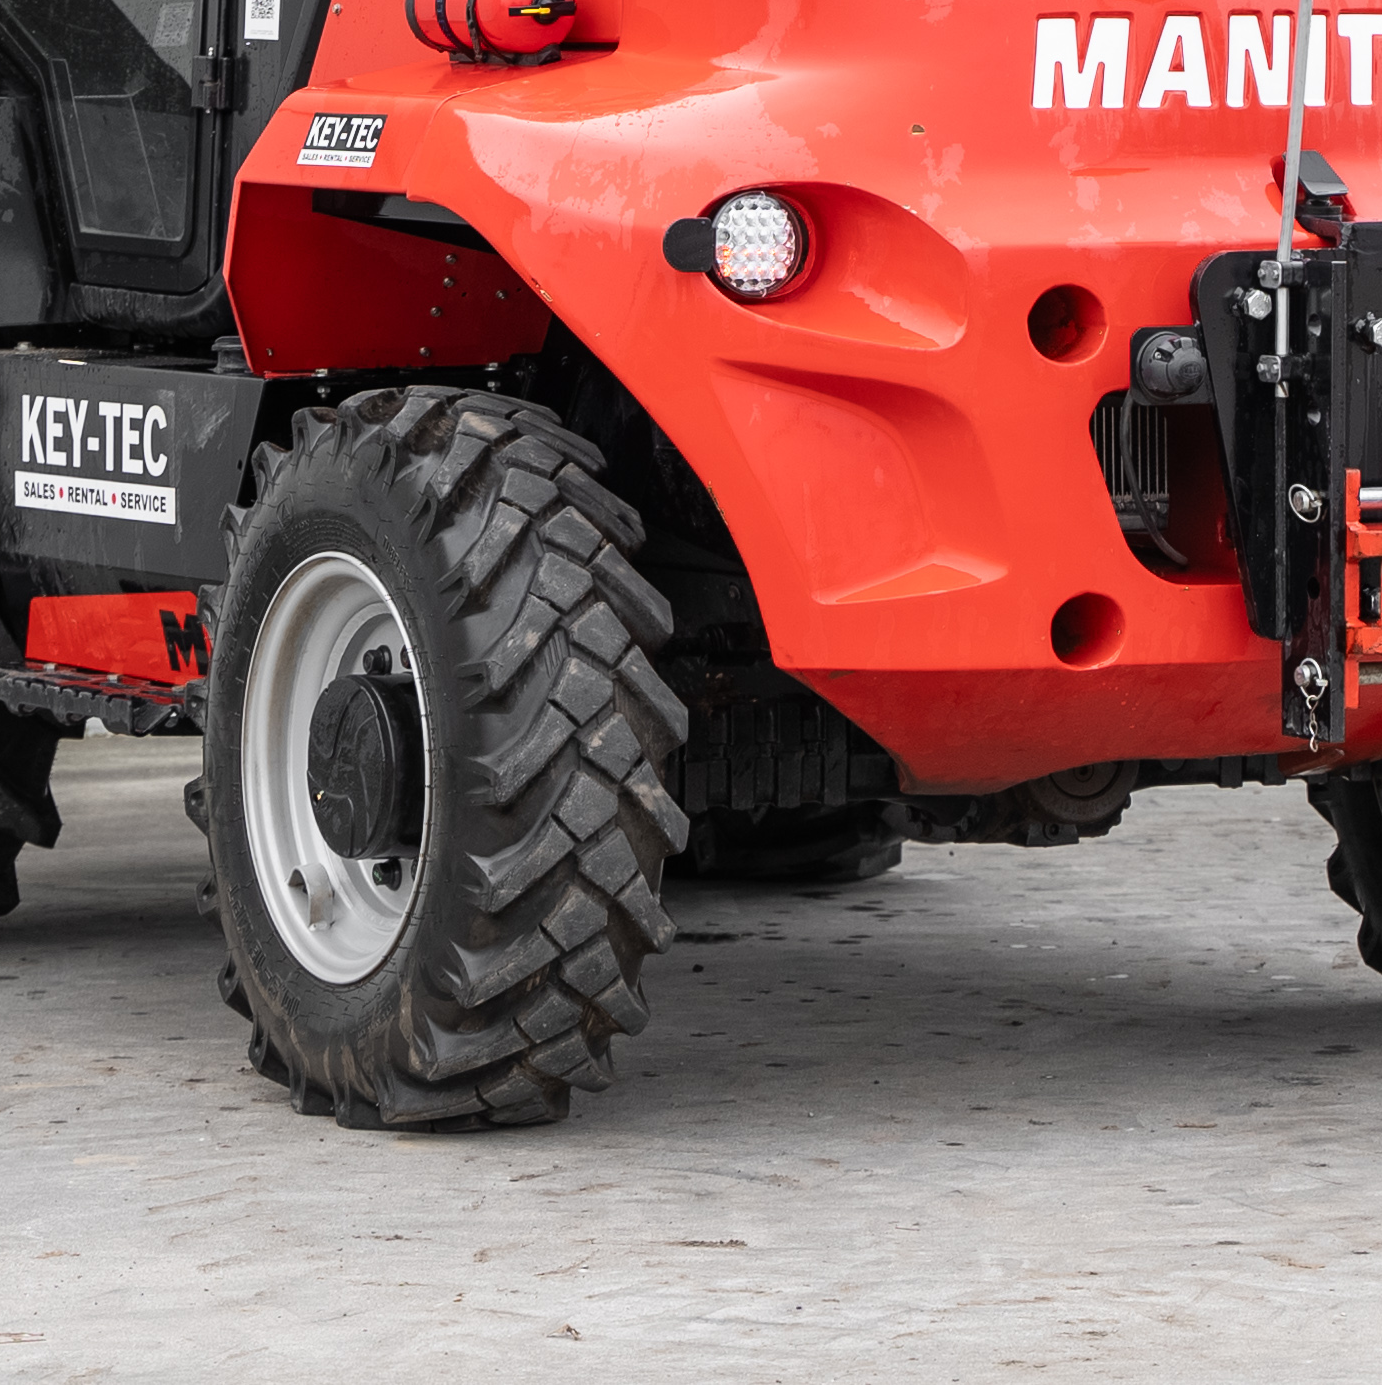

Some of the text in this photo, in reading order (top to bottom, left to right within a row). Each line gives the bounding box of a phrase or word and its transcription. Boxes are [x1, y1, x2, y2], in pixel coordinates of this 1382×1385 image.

[305, 116, 383, 149] KEY-TEC
[21, 394, 168, 477] KEY-TEC
[23, 481, 167, 513] SALES RENTAL SERVICE
